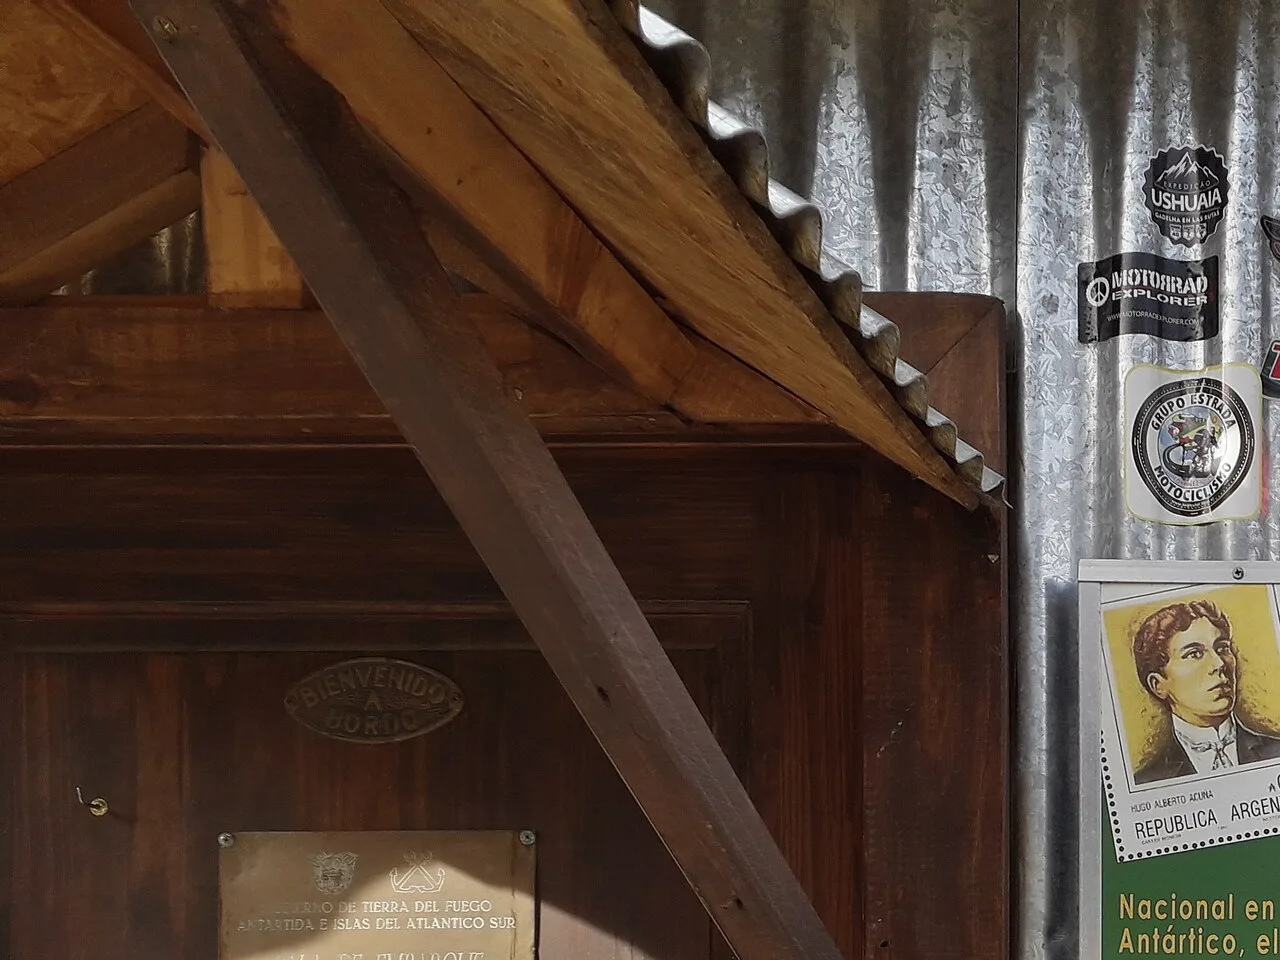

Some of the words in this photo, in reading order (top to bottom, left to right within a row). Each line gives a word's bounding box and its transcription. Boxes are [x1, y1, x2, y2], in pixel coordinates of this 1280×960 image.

[1151, 187, 1222, 211] USHUAIA
[1112, 267, 1208, 292] MOTORRAD
[1112, 288, 1208, 307] EXPLORER
[1151, 397, 1186, 430] GRUPO
[1190, 393, 1236, 430] ESTRADA
[1154, 461, 1232, 502] MOTOCICLISMO
[1131, 802, 1151, 814] HUGO
[1154, 795, 1187, 811] ALBERTO
[1134, 808, 1218, 840] REPUBLICA
[361, 901, 411, 915] TIERRA
[413, 901, 440, 915] DEL
[444, 900, 492, 914] FUEGO
[1119, 893, 1234, 921] Nacional
[1244, 898, 1276, 921] en
[333, 918, 372, 931] ISLAS
[375, 918, 401, 931] DEL
[405, 917, 485, 931] ATLANTICO
[488, 917, 517, 930] SUR
[1118, 924, 1246, 958] Antártico,
[1256, 928, 1279, 955] el
